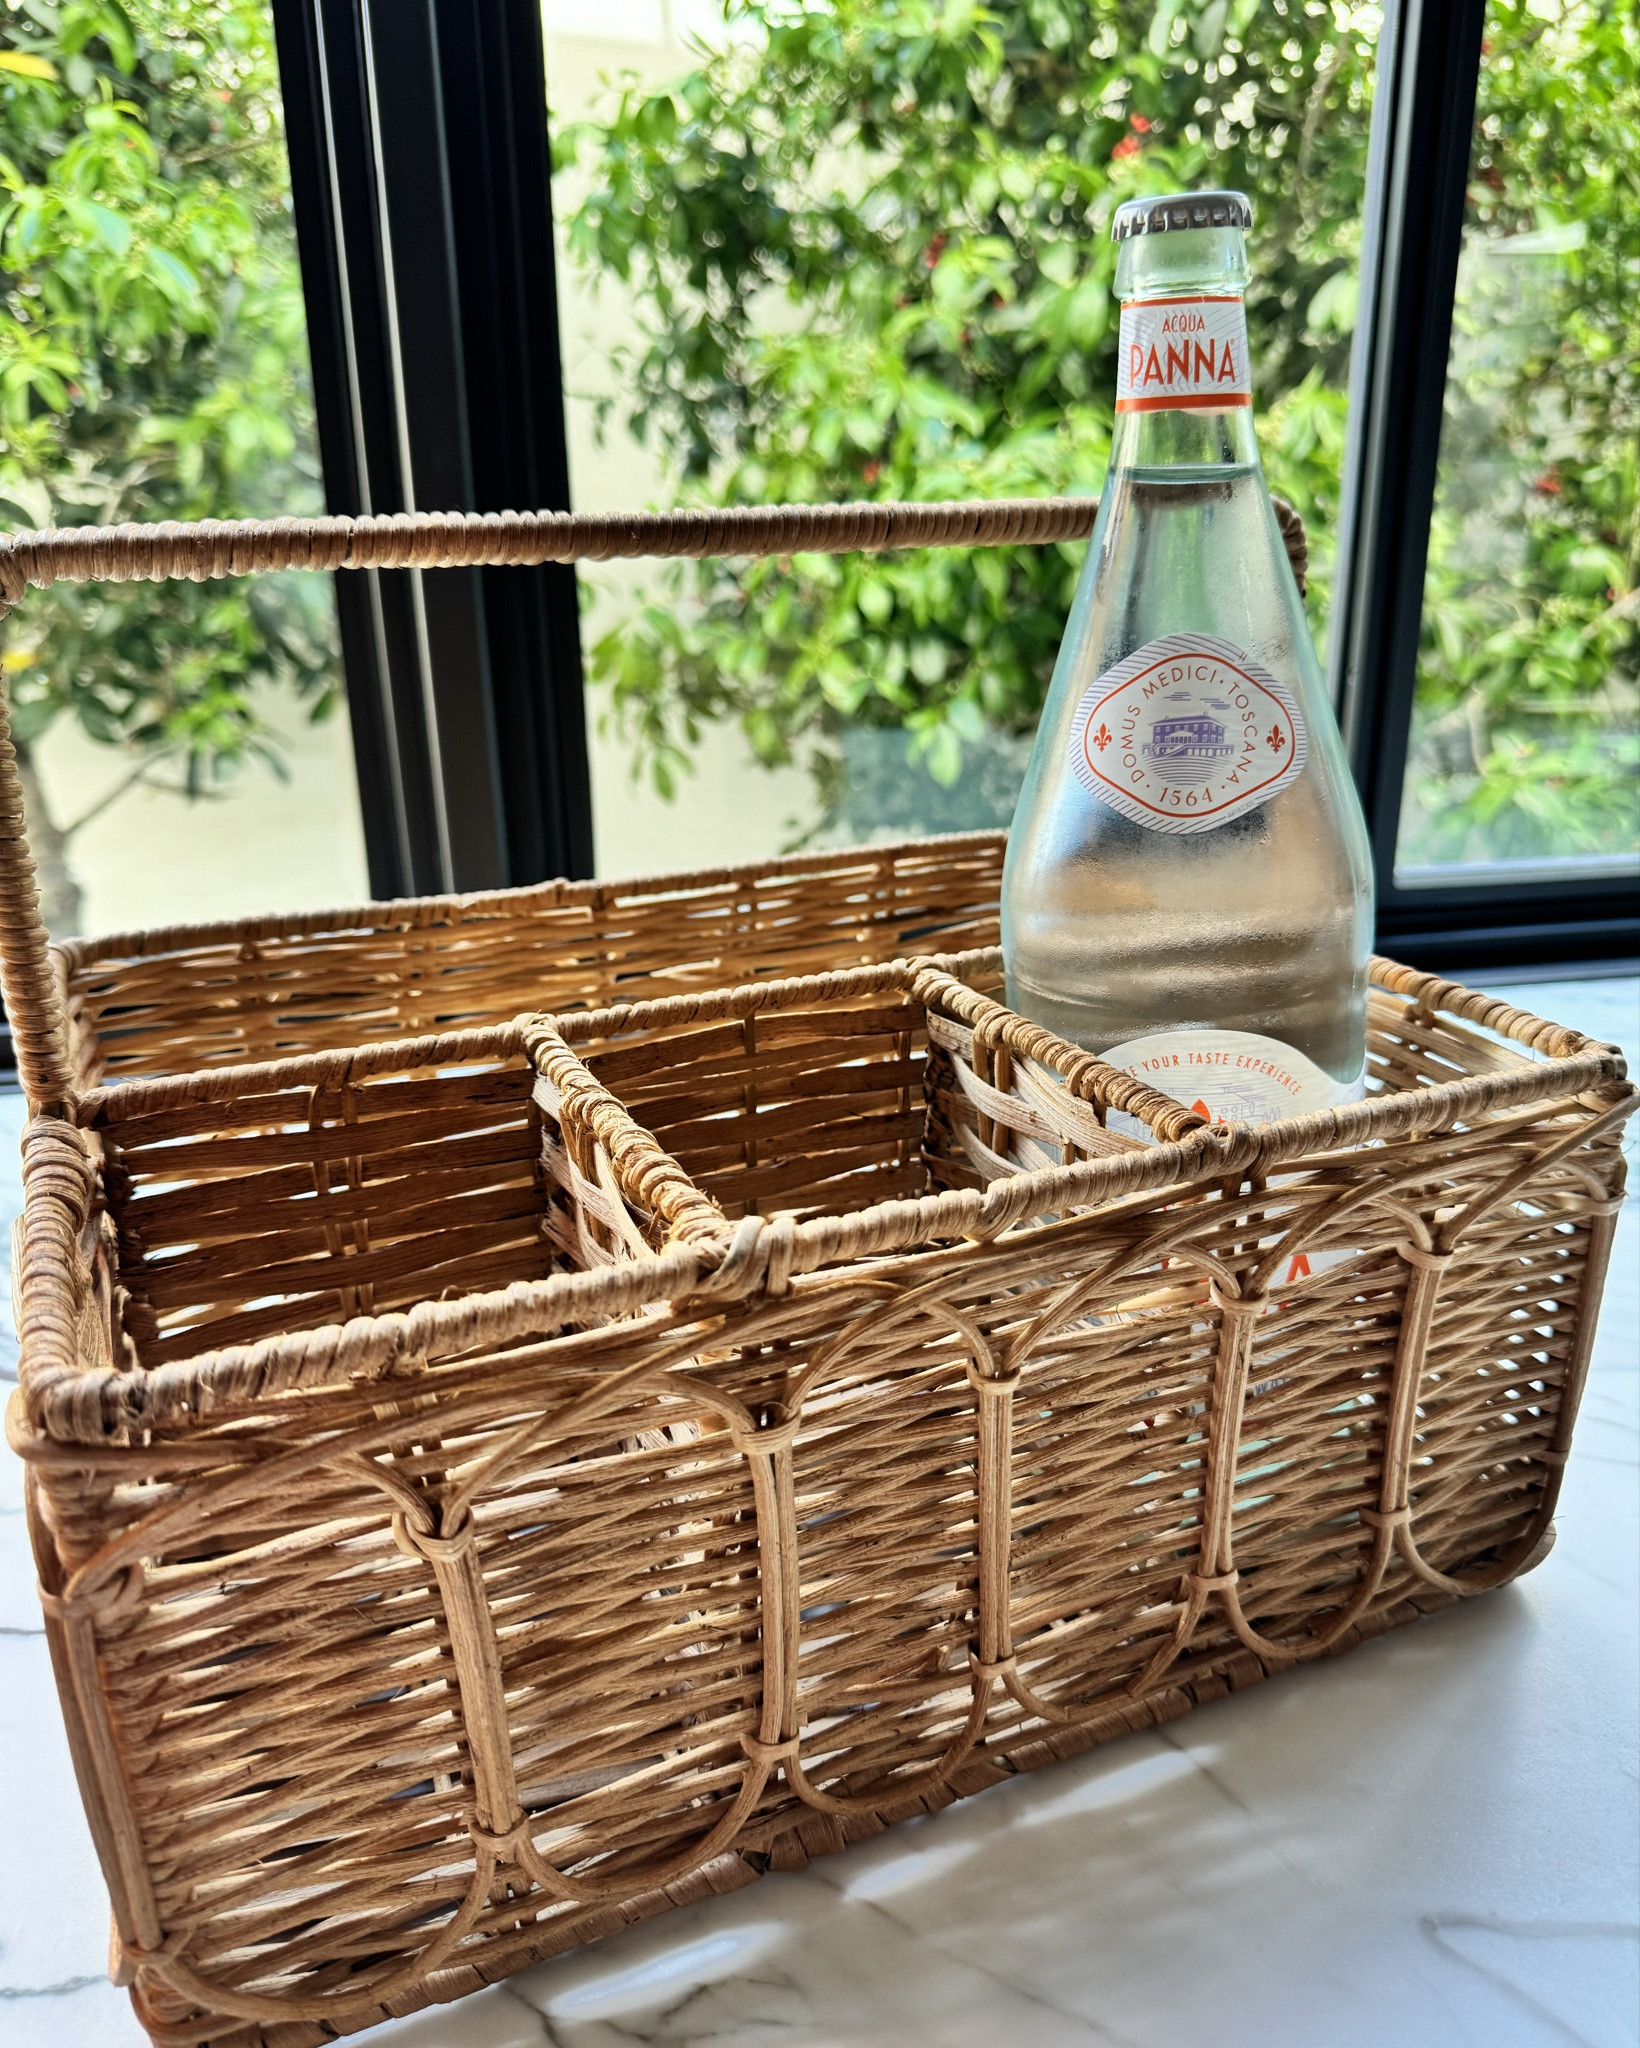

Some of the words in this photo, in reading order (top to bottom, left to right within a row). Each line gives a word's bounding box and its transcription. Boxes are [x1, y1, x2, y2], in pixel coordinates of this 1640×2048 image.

[1162, 314, 1206, 334] ACQUA
[1129, 338, 1236, 389] PANNA
[1120, 704, 1145, 784] DOMUS
[1141, 664, 1218, 700] MEDICI
[1226, 681, 1258, 784] TOSCANA
[1158, 786, 1214, 807] 1564
[1141, 1054, 1180, 1072] YOUR
[1187, 1052, 1230, 1065] TASTE
[1236, 1055, 1302, 1096] EXPERIENCE
